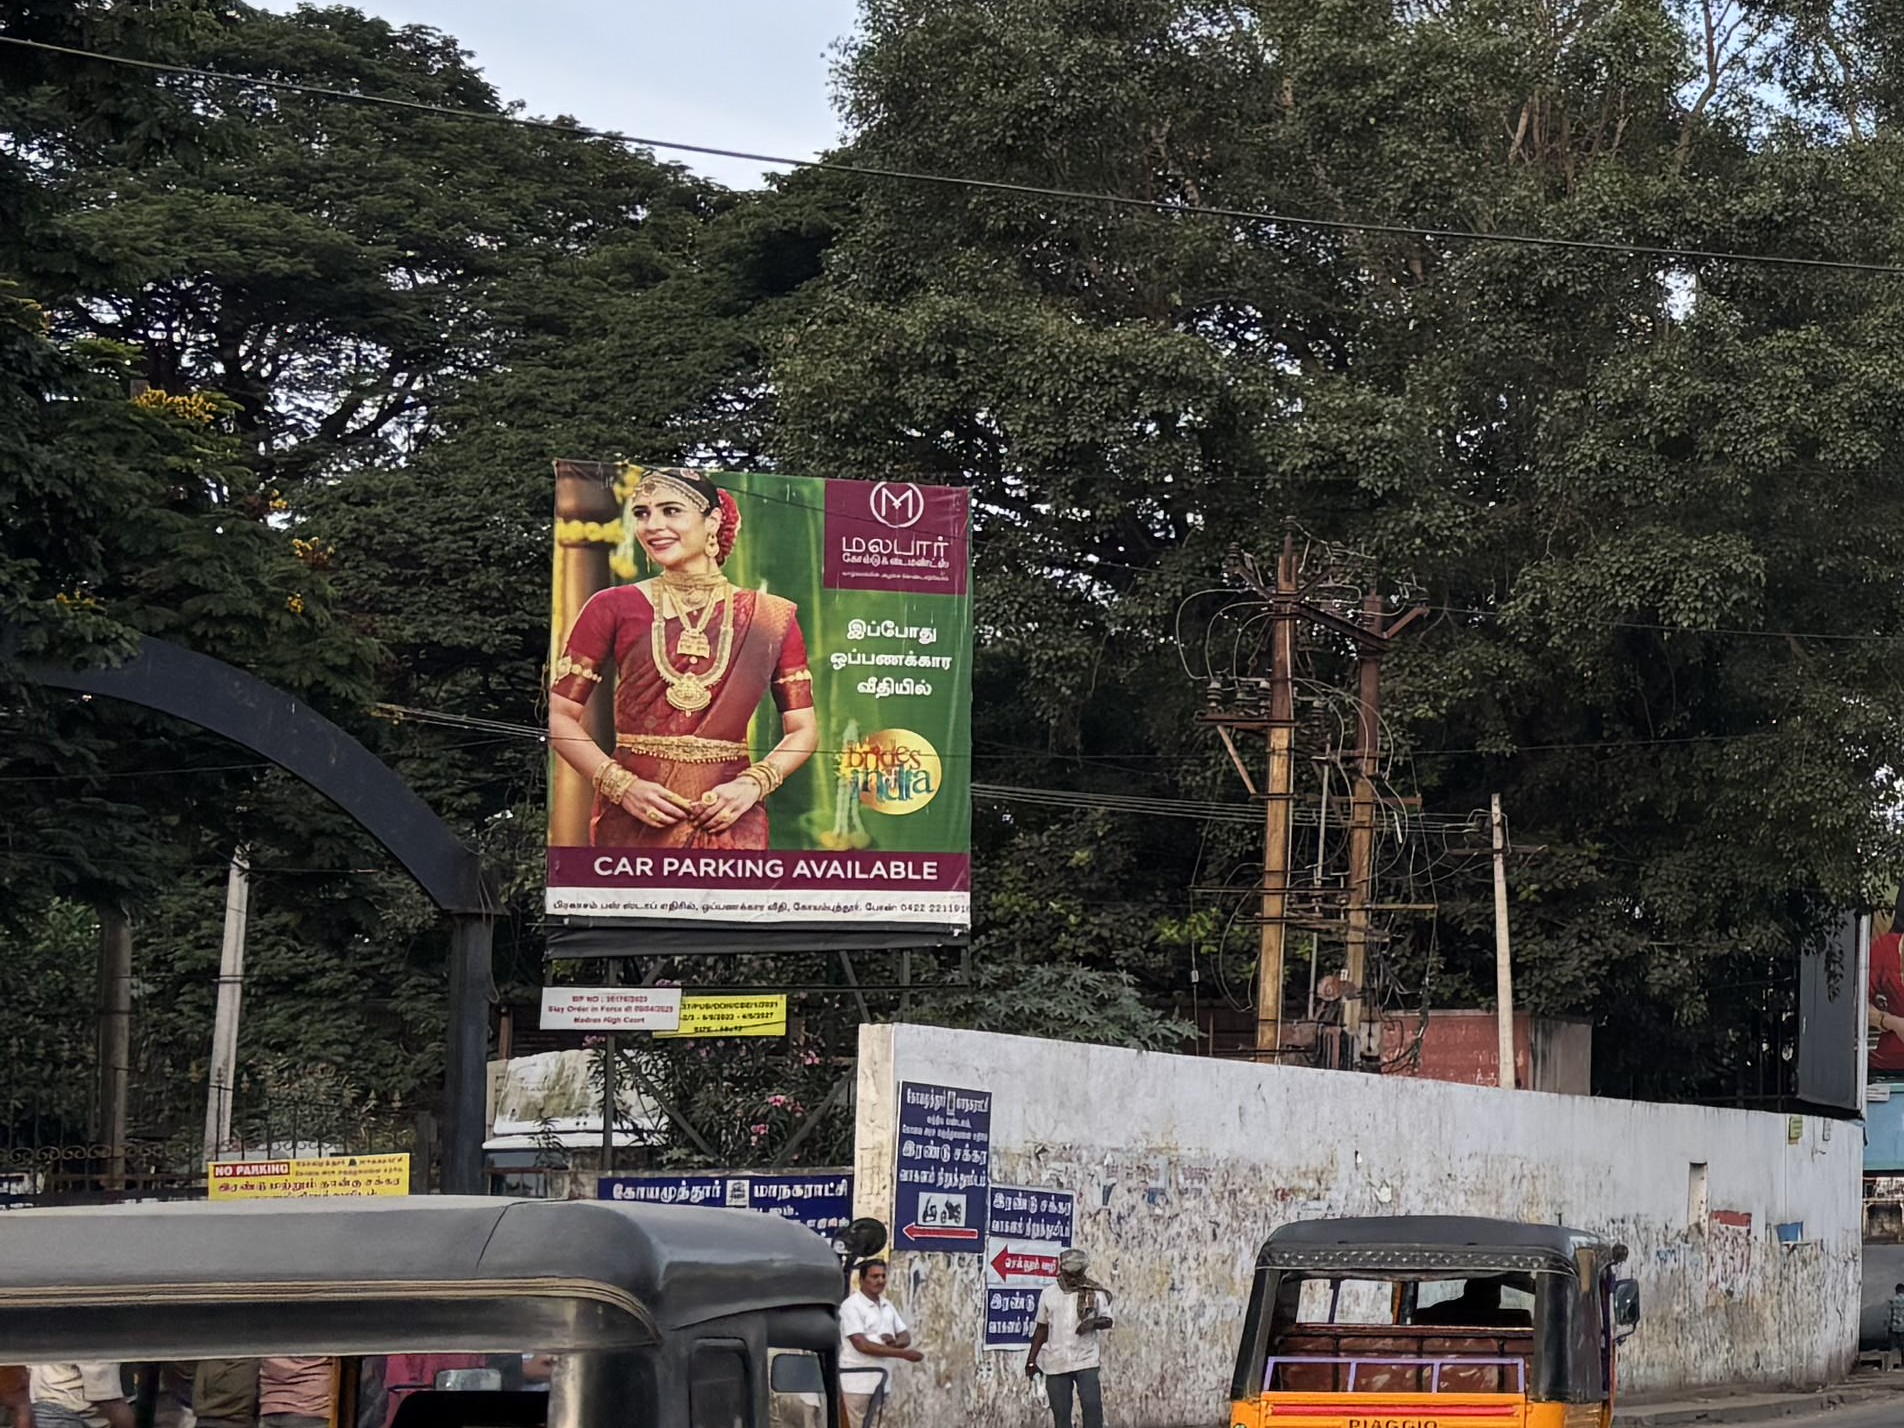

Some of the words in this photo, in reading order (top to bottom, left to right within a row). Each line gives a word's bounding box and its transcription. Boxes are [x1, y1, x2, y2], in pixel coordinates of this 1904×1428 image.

[842, 535, 949, 557] மலபார்
[847, 618, 937, 644] இப்போது
[830, 649, 952, 670] ஒப்பணக்கார
[857, 676, 933, 699] வீதியில்
[593, 856, 654, 877] CAR
[663, 858, 784, 879] PARKING
[792, 860, 938, 880] AVAILABLE
[902, 1140, 950, 1162] இரண்டு
[953, 1143, 987, 1165] சக்கர
[215, 1168, 233, 1176] NO
[236, 1165, 289, 1176] PARKING
[613, 1180, 721, 1203] கோயமுத்தூர்
[754, 1179, 848, 1201] மாநகராட்சி
[993, 1192, 1037, 1213] இரண்டு
[1040, 1195, 1071, 1216] சக்கர
[990, 1292, 1035, 1313] இரண்டு
